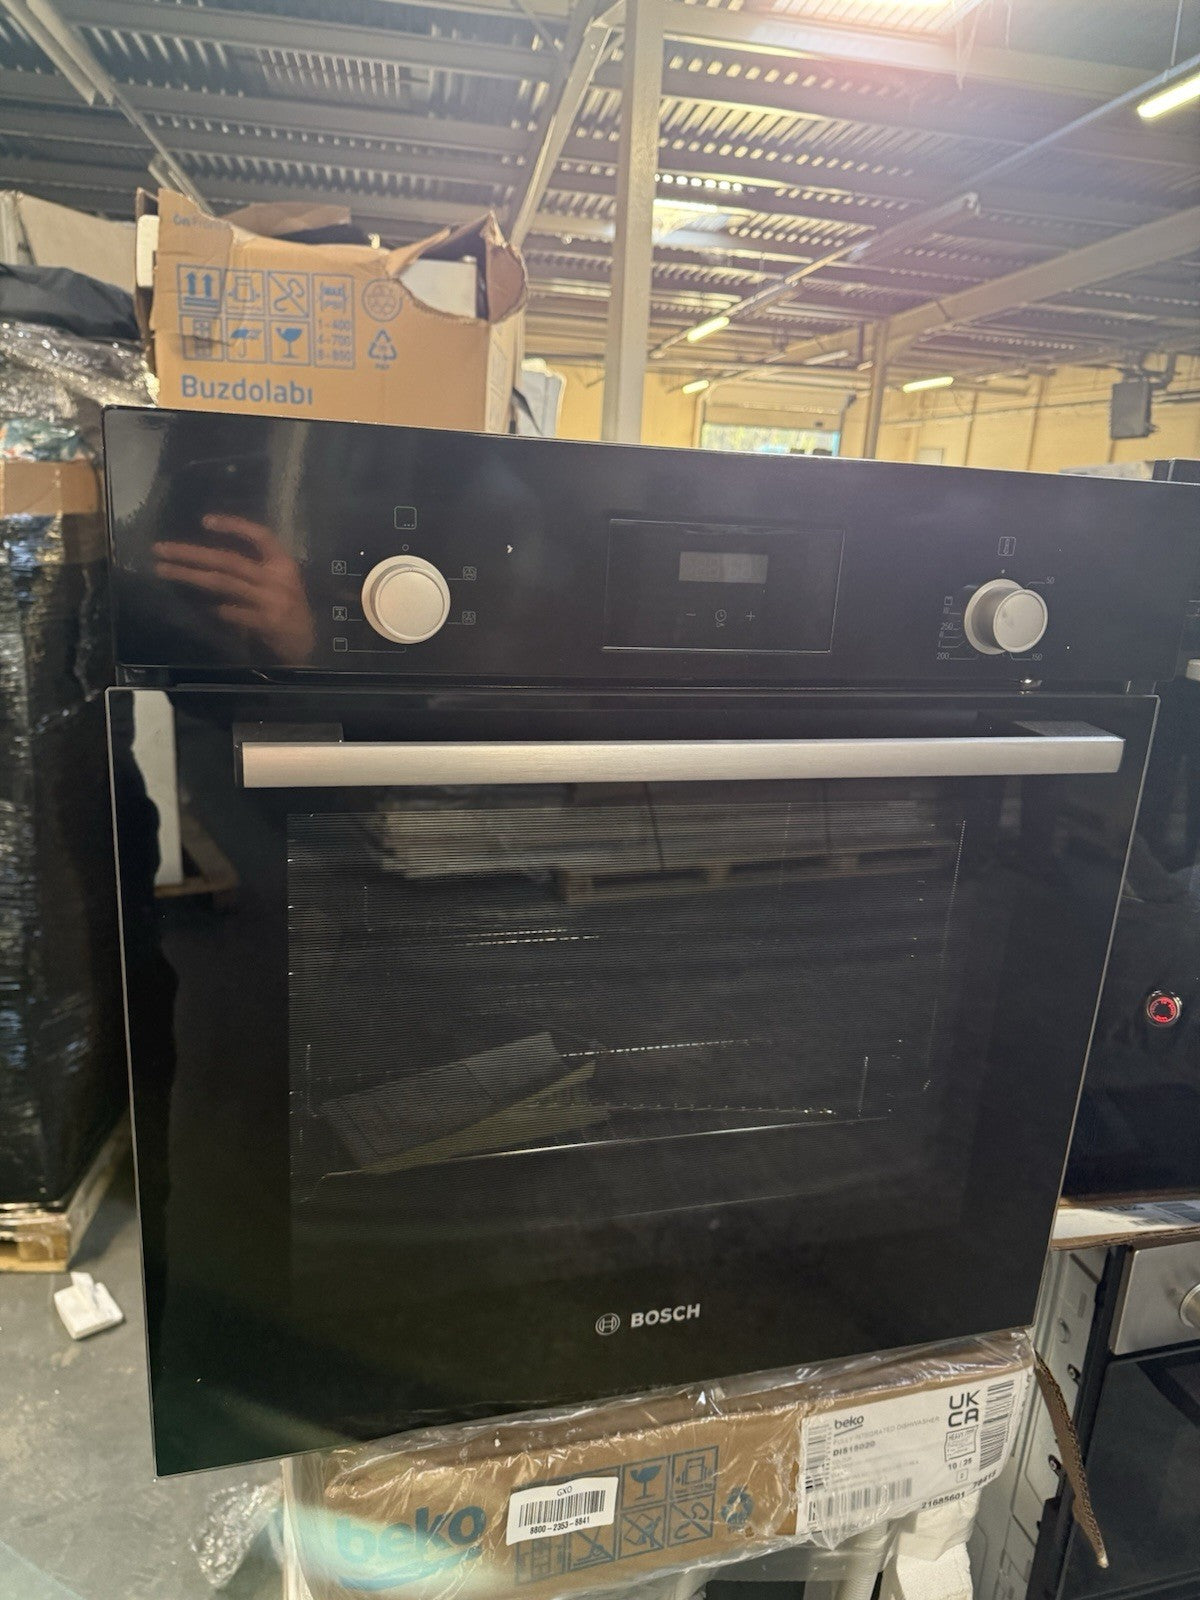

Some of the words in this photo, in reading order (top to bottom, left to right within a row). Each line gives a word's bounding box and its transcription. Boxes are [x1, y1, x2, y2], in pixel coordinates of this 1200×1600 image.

[181, 375, 314, 405] Buzdolabı
[630, 1303, 700, 1328] BOSCH
[949, 1390, 980, 1409] UK
[834, 1415, 864, 1429] beko
[948, 1408, 979, 1427] CA
[556, 1485, 573, 1497] GXO
[336, 1505, 487, 1564] beko
